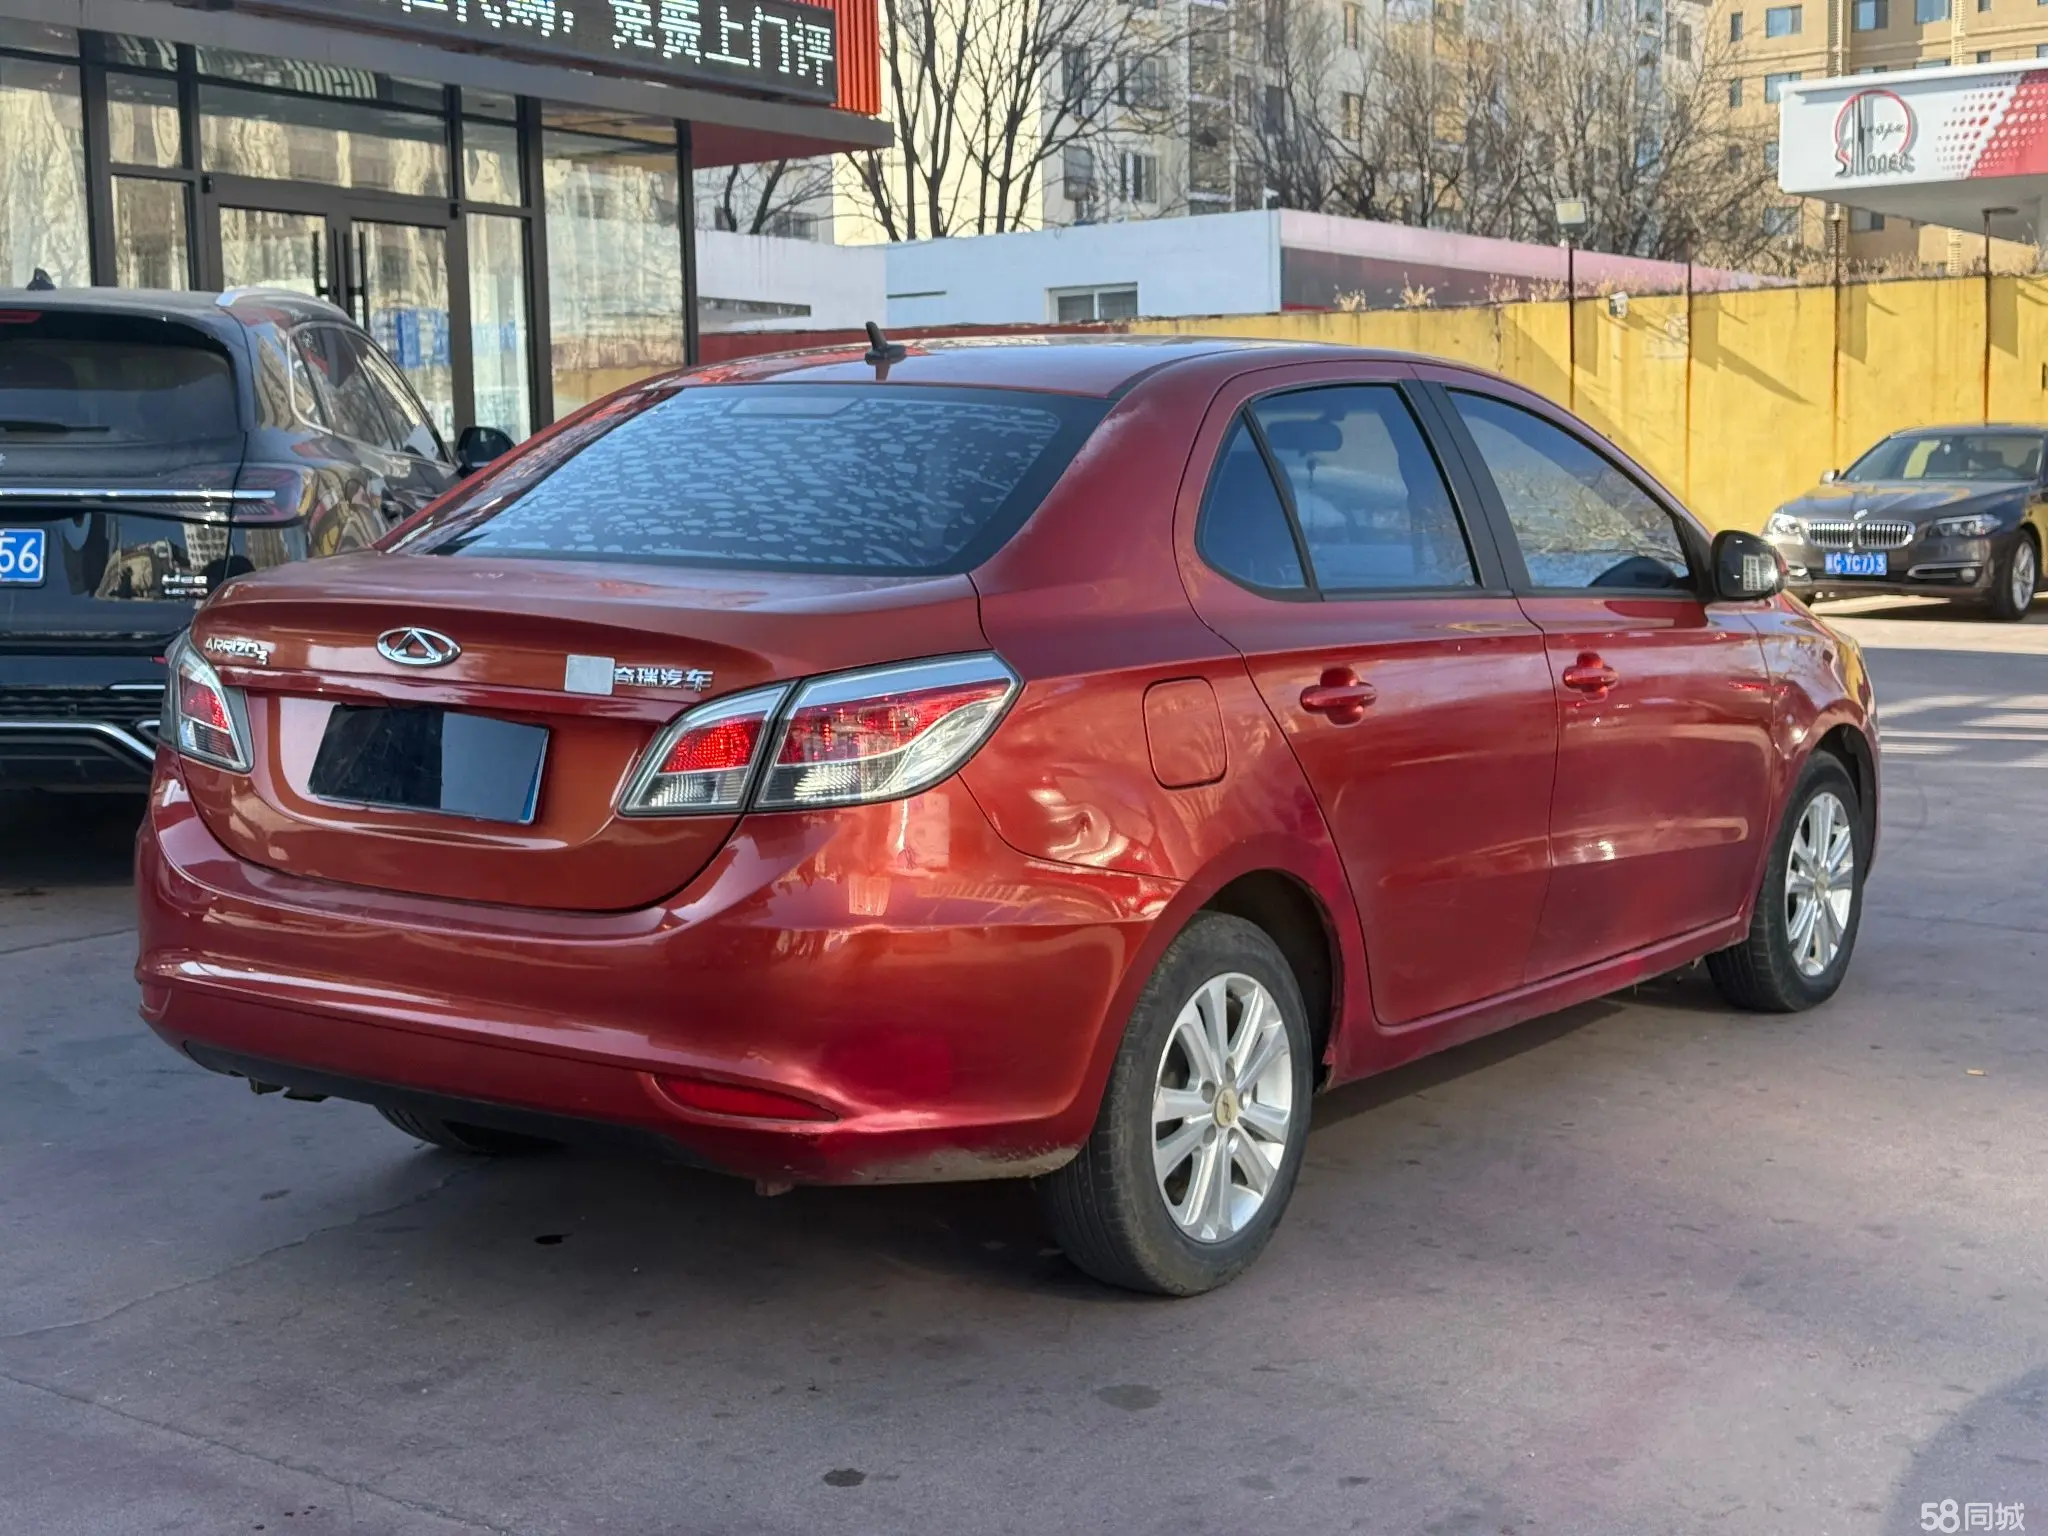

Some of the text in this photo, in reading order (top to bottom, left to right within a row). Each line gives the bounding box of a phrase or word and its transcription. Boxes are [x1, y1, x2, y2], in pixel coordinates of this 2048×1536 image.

[0, 537, 39, 573] 56
[614, 666, 714, 692] 奇瑞汽车
